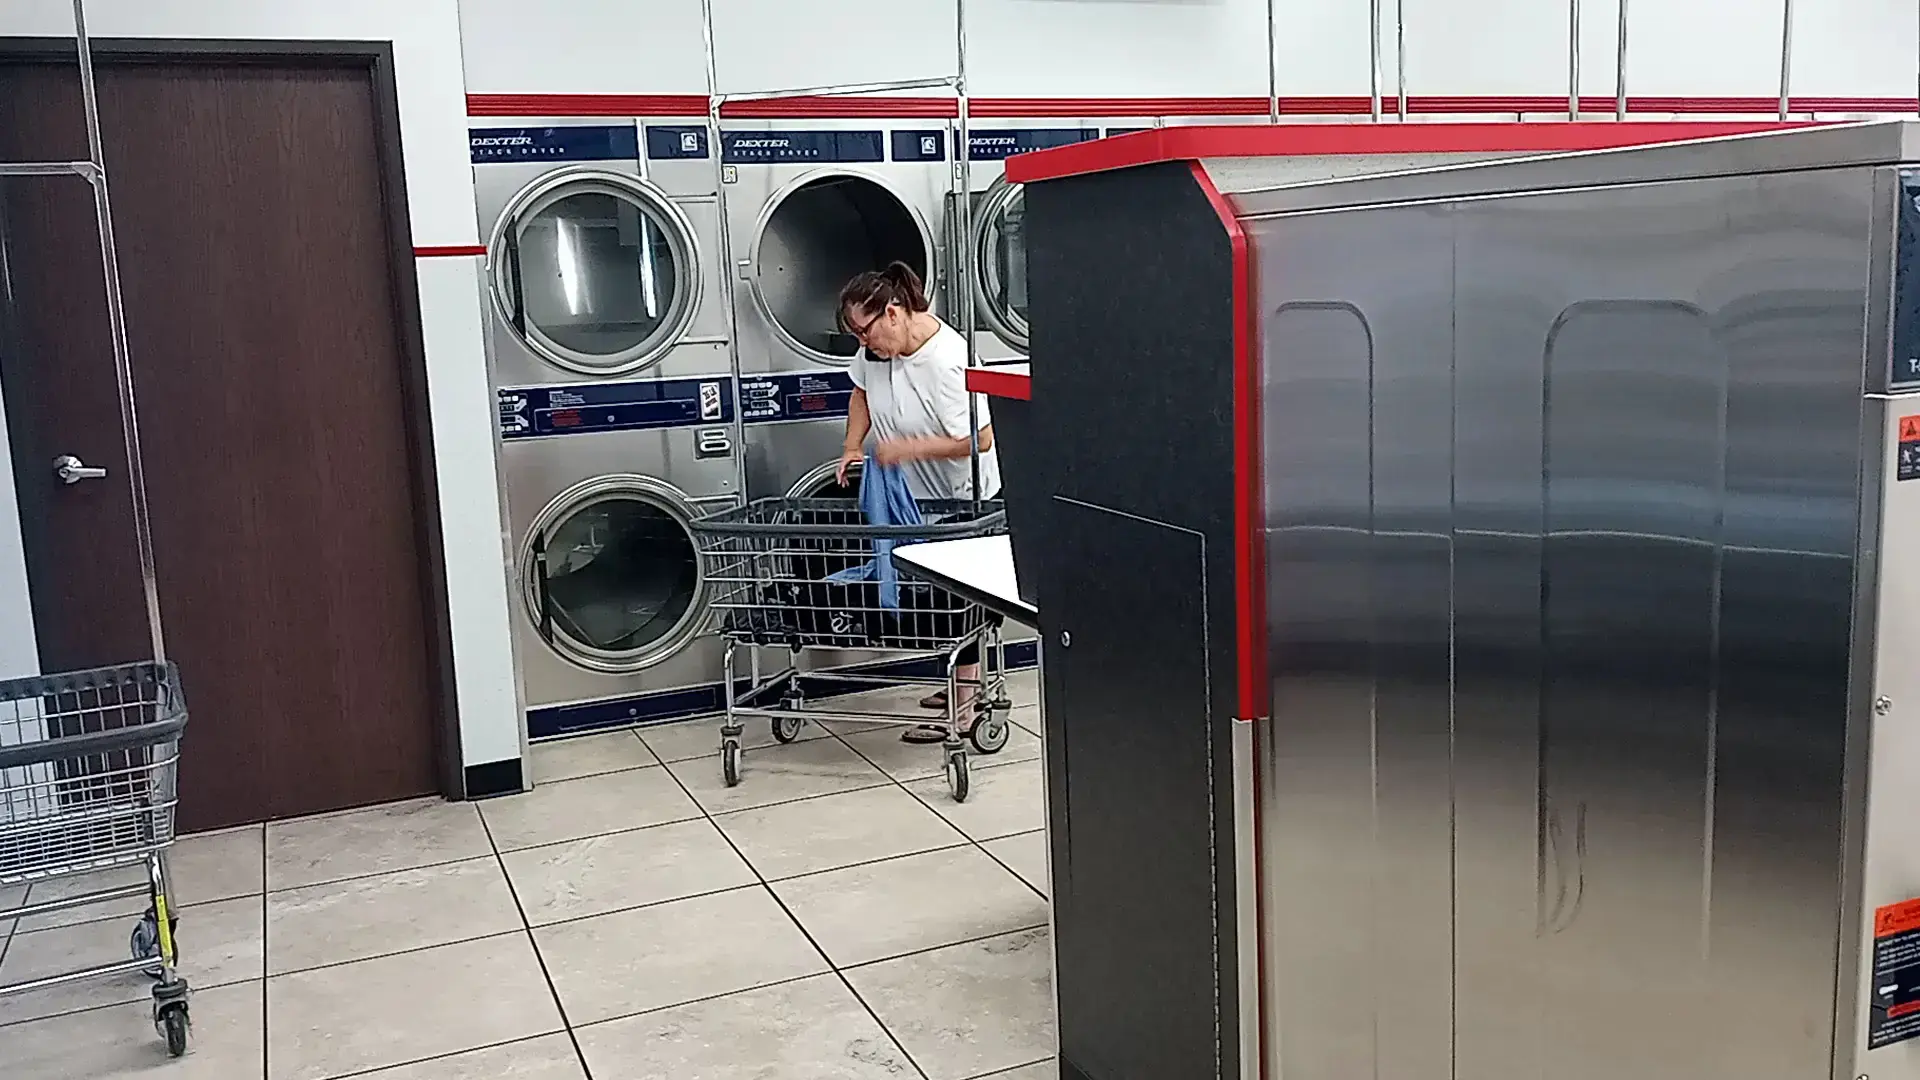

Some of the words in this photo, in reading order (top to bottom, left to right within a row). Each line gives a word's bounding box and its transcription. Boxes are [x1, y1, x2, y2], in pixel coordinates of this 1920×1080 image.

[471, 137, 533, 145] DEXTER
[733, 139, 789, 148] DEXTER
[968, 137, 1016, 145] DEXTER
[522, 147, 565, 155] DRYER
